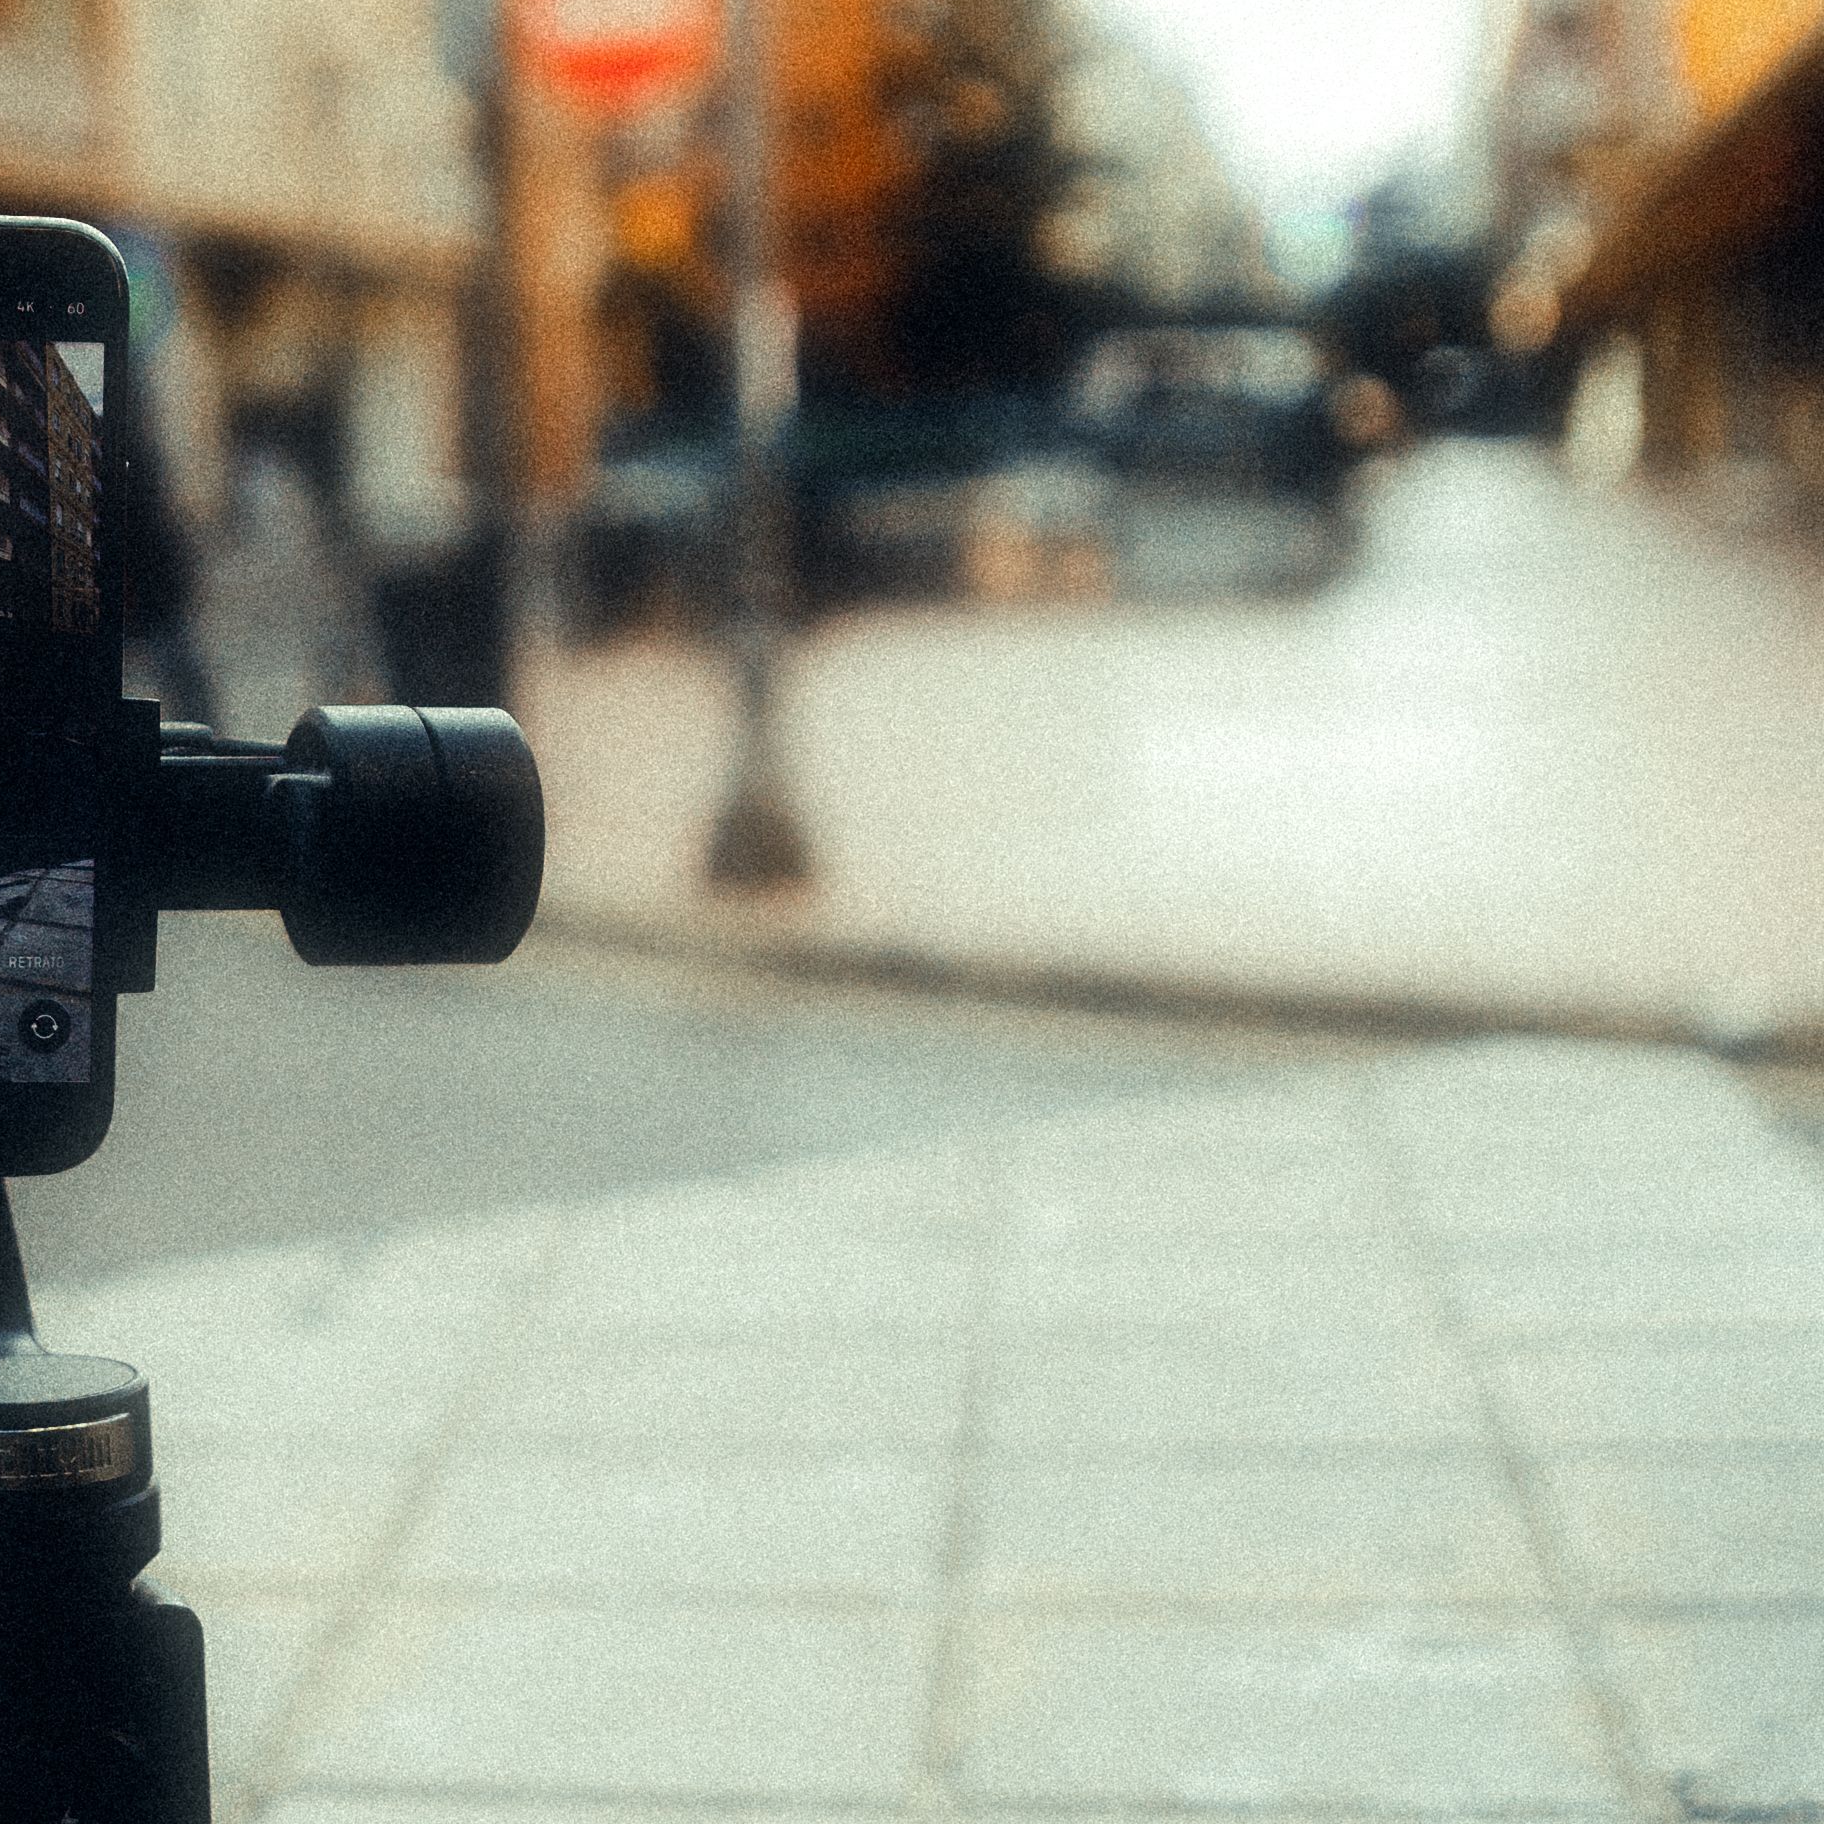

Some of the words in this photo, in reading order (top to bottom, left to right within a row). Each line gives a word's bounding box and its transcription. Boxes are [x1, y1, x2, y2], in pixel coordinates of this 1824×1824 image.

[16, 300, 35, 313] 4K
[67, 302, 85, 315] 60
[8, 955, 65, 969] RETRATO
